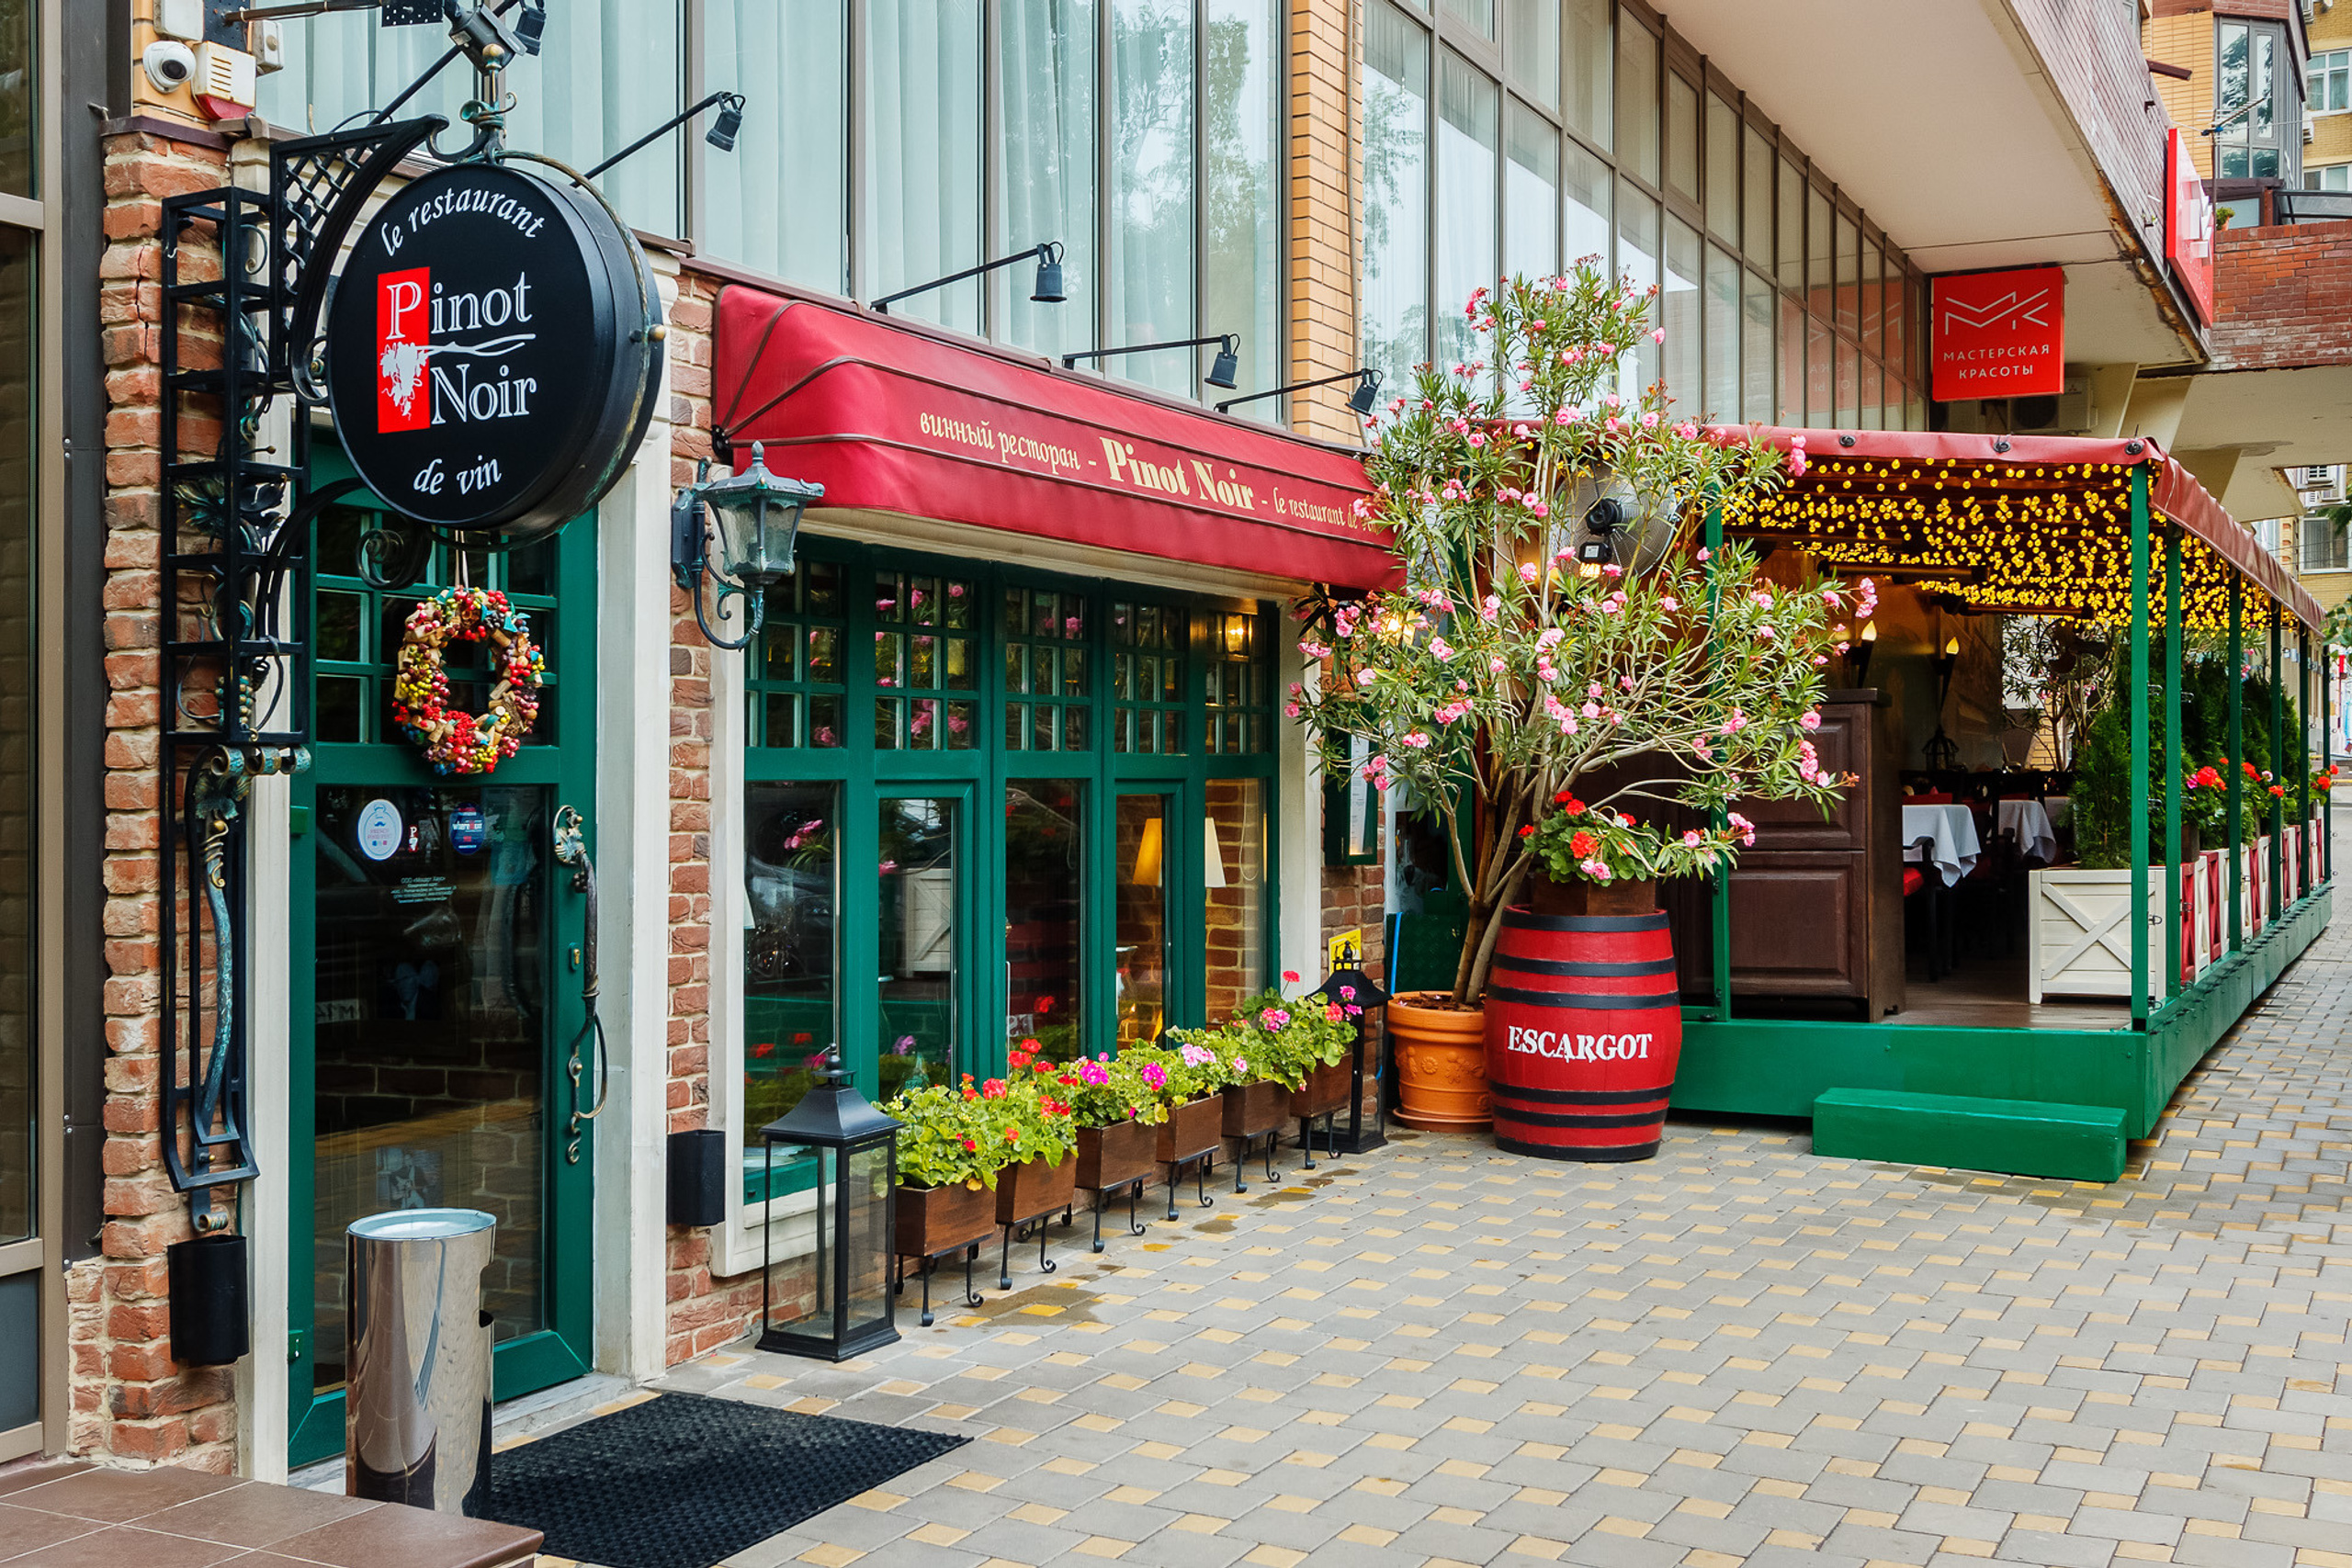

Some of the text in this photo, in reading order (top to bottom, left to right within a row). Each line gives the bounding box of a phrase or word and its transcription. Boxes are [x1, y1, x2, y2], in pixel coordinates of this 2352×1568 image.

[381, 186, 546, 256] le restaurant
[385, 271, 534, 341] Pinot
[1943, 344, 2050, 362] МАСТЕРСКАЯ
[1959, 364, 2033, 379] КРАСОТЫ
[430, 363, 537, 425] Noir
[920, 412, 996, 450] винный
[998, 431, 1081, 475] ресторан
[413, 455, 502, 495] de vin
[1099, 436, 1190, 496] Pinot
[1190, 459, 1256, 511] Noir
[1272, 487, 1287, 514] le
[1288, 498, 1346, 526] restaurant
[1507, 1025, 1653, 1064] ESCARGOT
